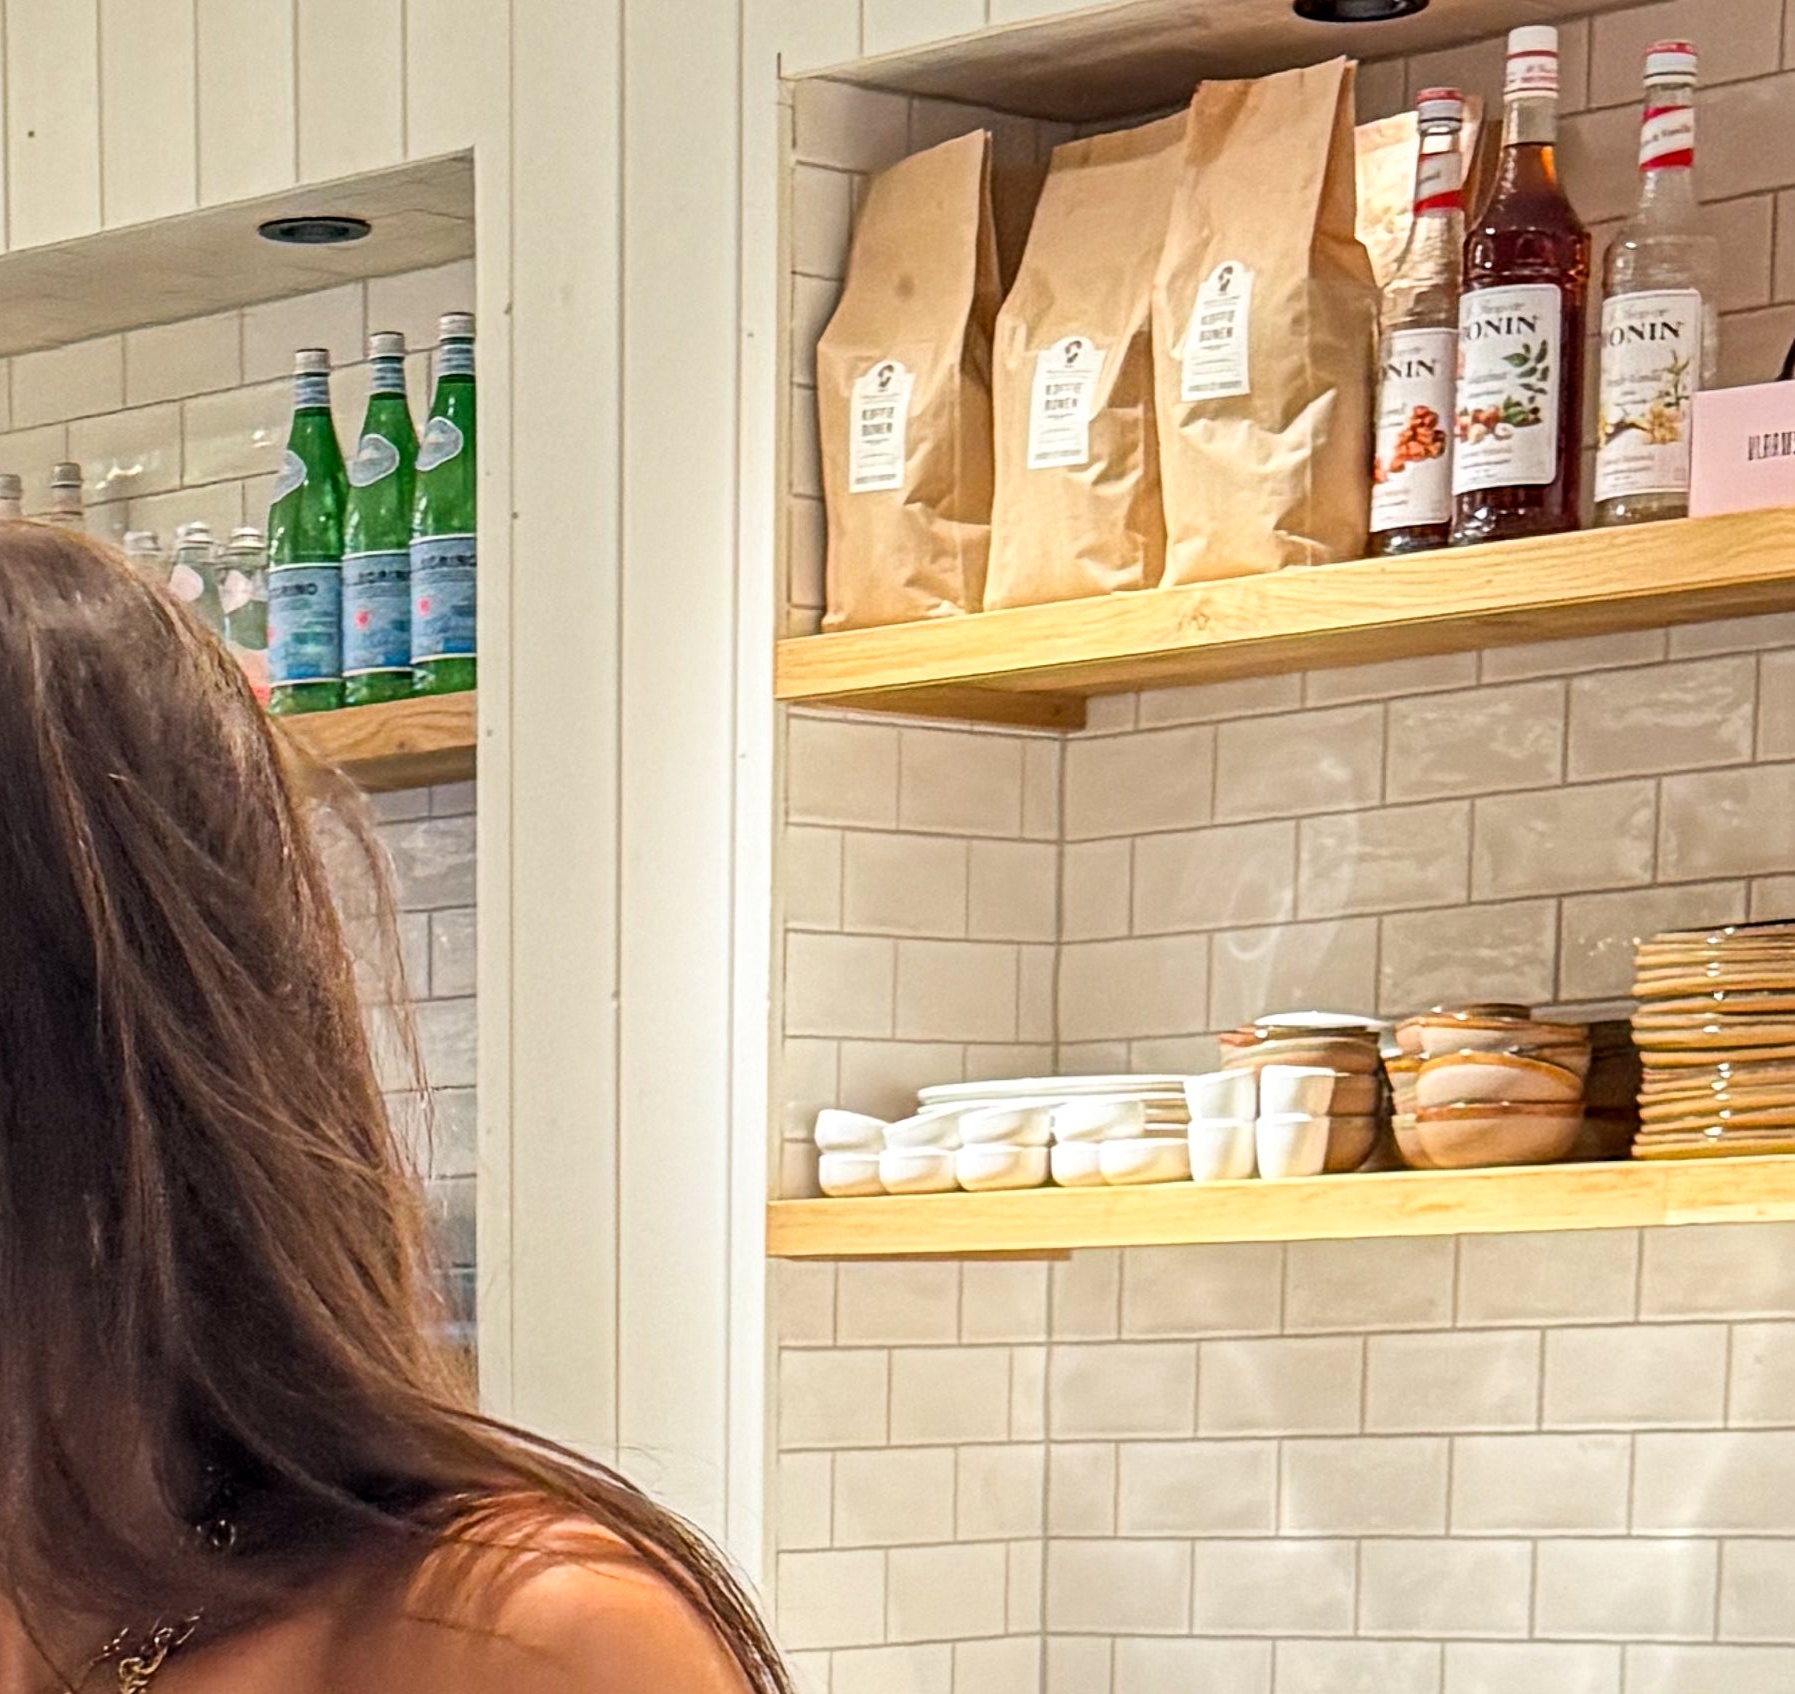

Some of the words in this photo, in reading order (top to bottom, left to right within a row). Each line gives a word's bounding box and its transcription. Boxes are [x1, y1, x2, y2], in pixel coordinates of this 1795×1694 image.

[1463, 316, 1537, 343] ONIN
[1608, 320, 1682, 348] ONIN
[1381, 359, 1436, 380] NIN
